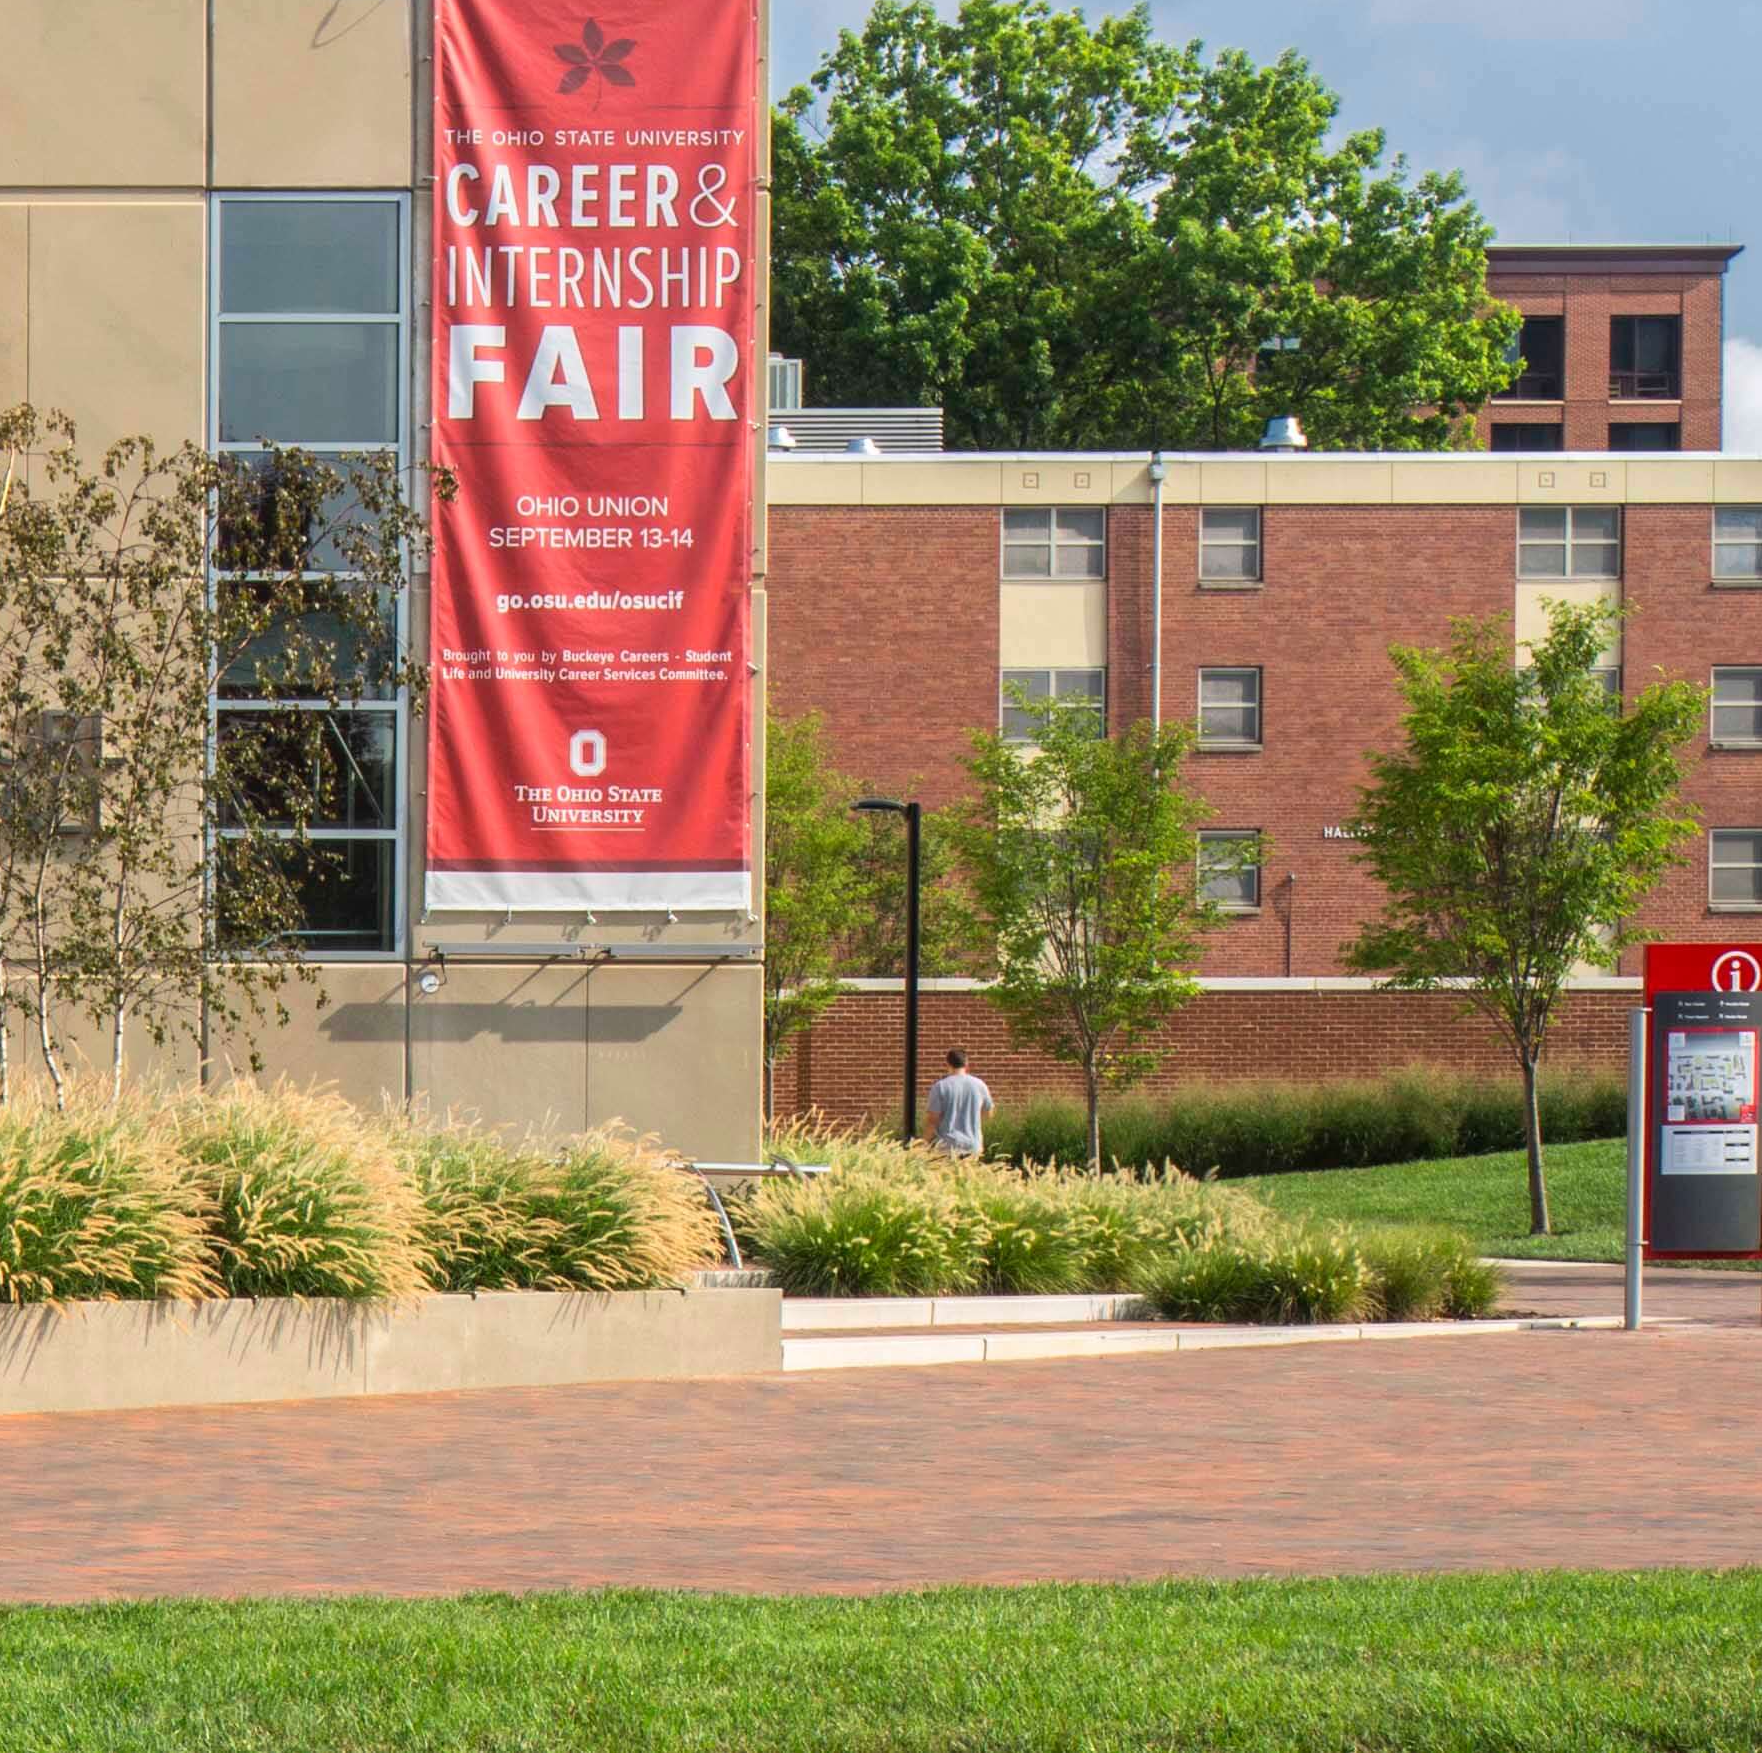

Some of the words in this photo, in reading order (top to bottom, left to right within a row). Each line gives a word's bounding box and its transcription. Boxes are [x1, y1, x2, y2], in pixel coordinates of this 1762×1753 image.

[444, 129, 483, 145] THE
[492, 130, 544, 146] OHIO
[555, 130, 614, 146] STATE
[626, 130, 744, 146] UNIVERSITY
[446, 163, 680, 228] CAREER
[448, 245, 742, 309] INTERNSHIP
[448, 324, 740, 421] FAIR
[516, 495, 579, 517] OHIO
[587, 495, 668, 517] UNION
[489, 527, 632, 548] SEPTEMBER
[639, 528, 694, 548] 13-14
[495, 590, 684, 613] go.osu.edu/osucif
[442, 648, 491, 664] Brought
[496, 650, 508, 662] to
[513, 652, 535, 665] you
[541, 650, 557, 665] by
[562, 649, 615, 665] Buckeye
[620, 649, 669, 663] Careers
[685, 649, 732, 663] Student
[442, 666, 465, 680] Life
[468, 667, 492, 680] and
[495, 666, 556, 683] University
[559, 667, 599, 680] Career
[603, 667, 656, 680] Services
[659, 667, 729, 680] Committee.
[514, 785, 552, 803] THE
[557, 785, 603, 803] OHIO
[608, 785, 663, 803] STATE
[532, 806, 645, 824] UNIVERSITY
